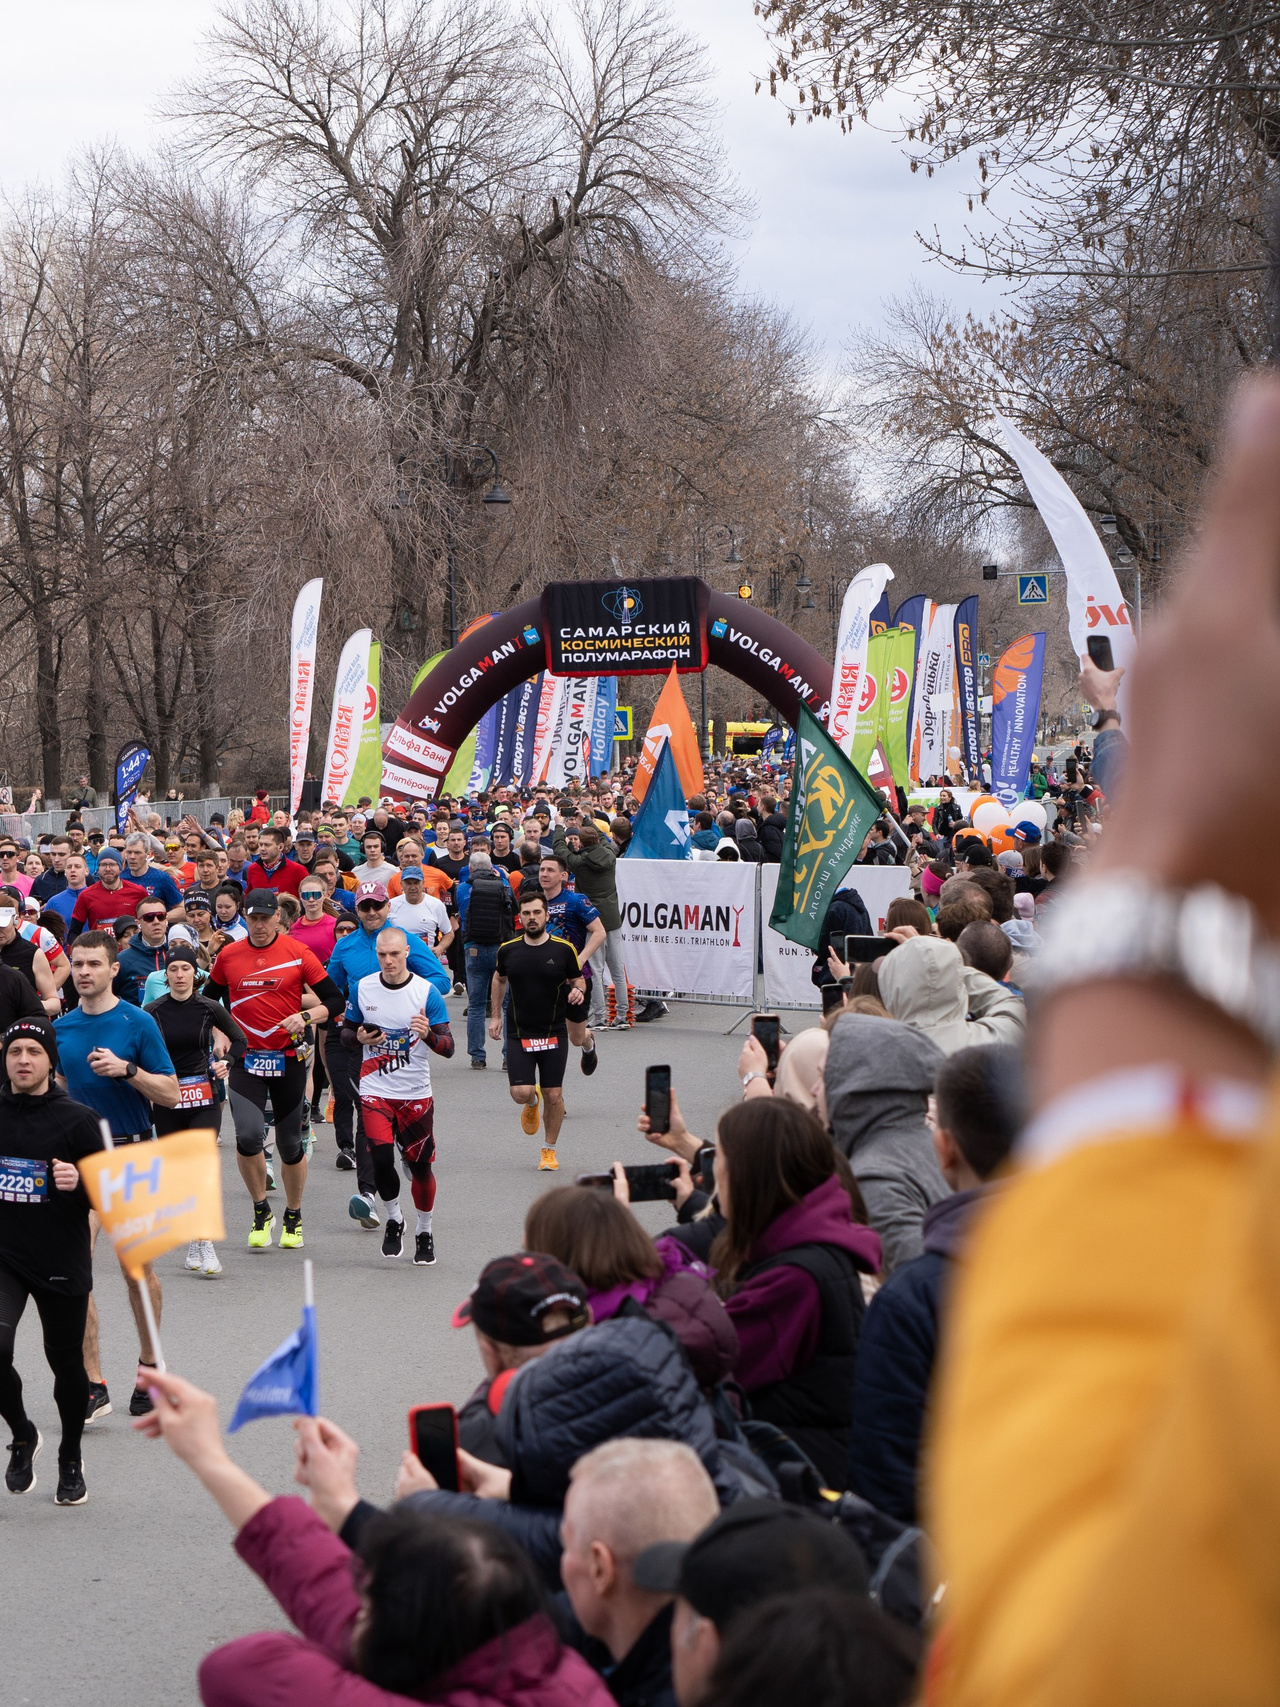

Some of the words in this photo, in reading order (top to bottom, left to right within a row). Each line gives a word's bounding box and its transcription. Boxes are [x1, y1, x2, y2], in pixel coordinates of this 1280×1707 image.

[560, 620, 690, 639] САМАРСКИЙ
[561, 634, 690, 651] КОСМИЧЕСКИЙ
[961, 625, 971, 663] PRO
[561, 648, 690, 664] ПОЛУМАРАФОН
[729, 628, 813, 699] VOLGAMAN
[434, 641, 517, 715] VOLGAMAN
[1013, 674, 1028, 733] INNOVATION
[592, 696, 610, 762] Holiday
[391, 729, 422, 754] Альфа
[422, 745, 447, 765] Банк
[1007, 736, 1022, 777] HEALTHY
[121, 754, 140, 779] 1:44
[387, 772, 435, 793] Пятёрочка
[361, 884, 377, 895] W
[690, 937, 730, 947] TRIATHLON
[253, 1058, 277, 1070] 2201
[378, 1055, 411, 1077] RUN
